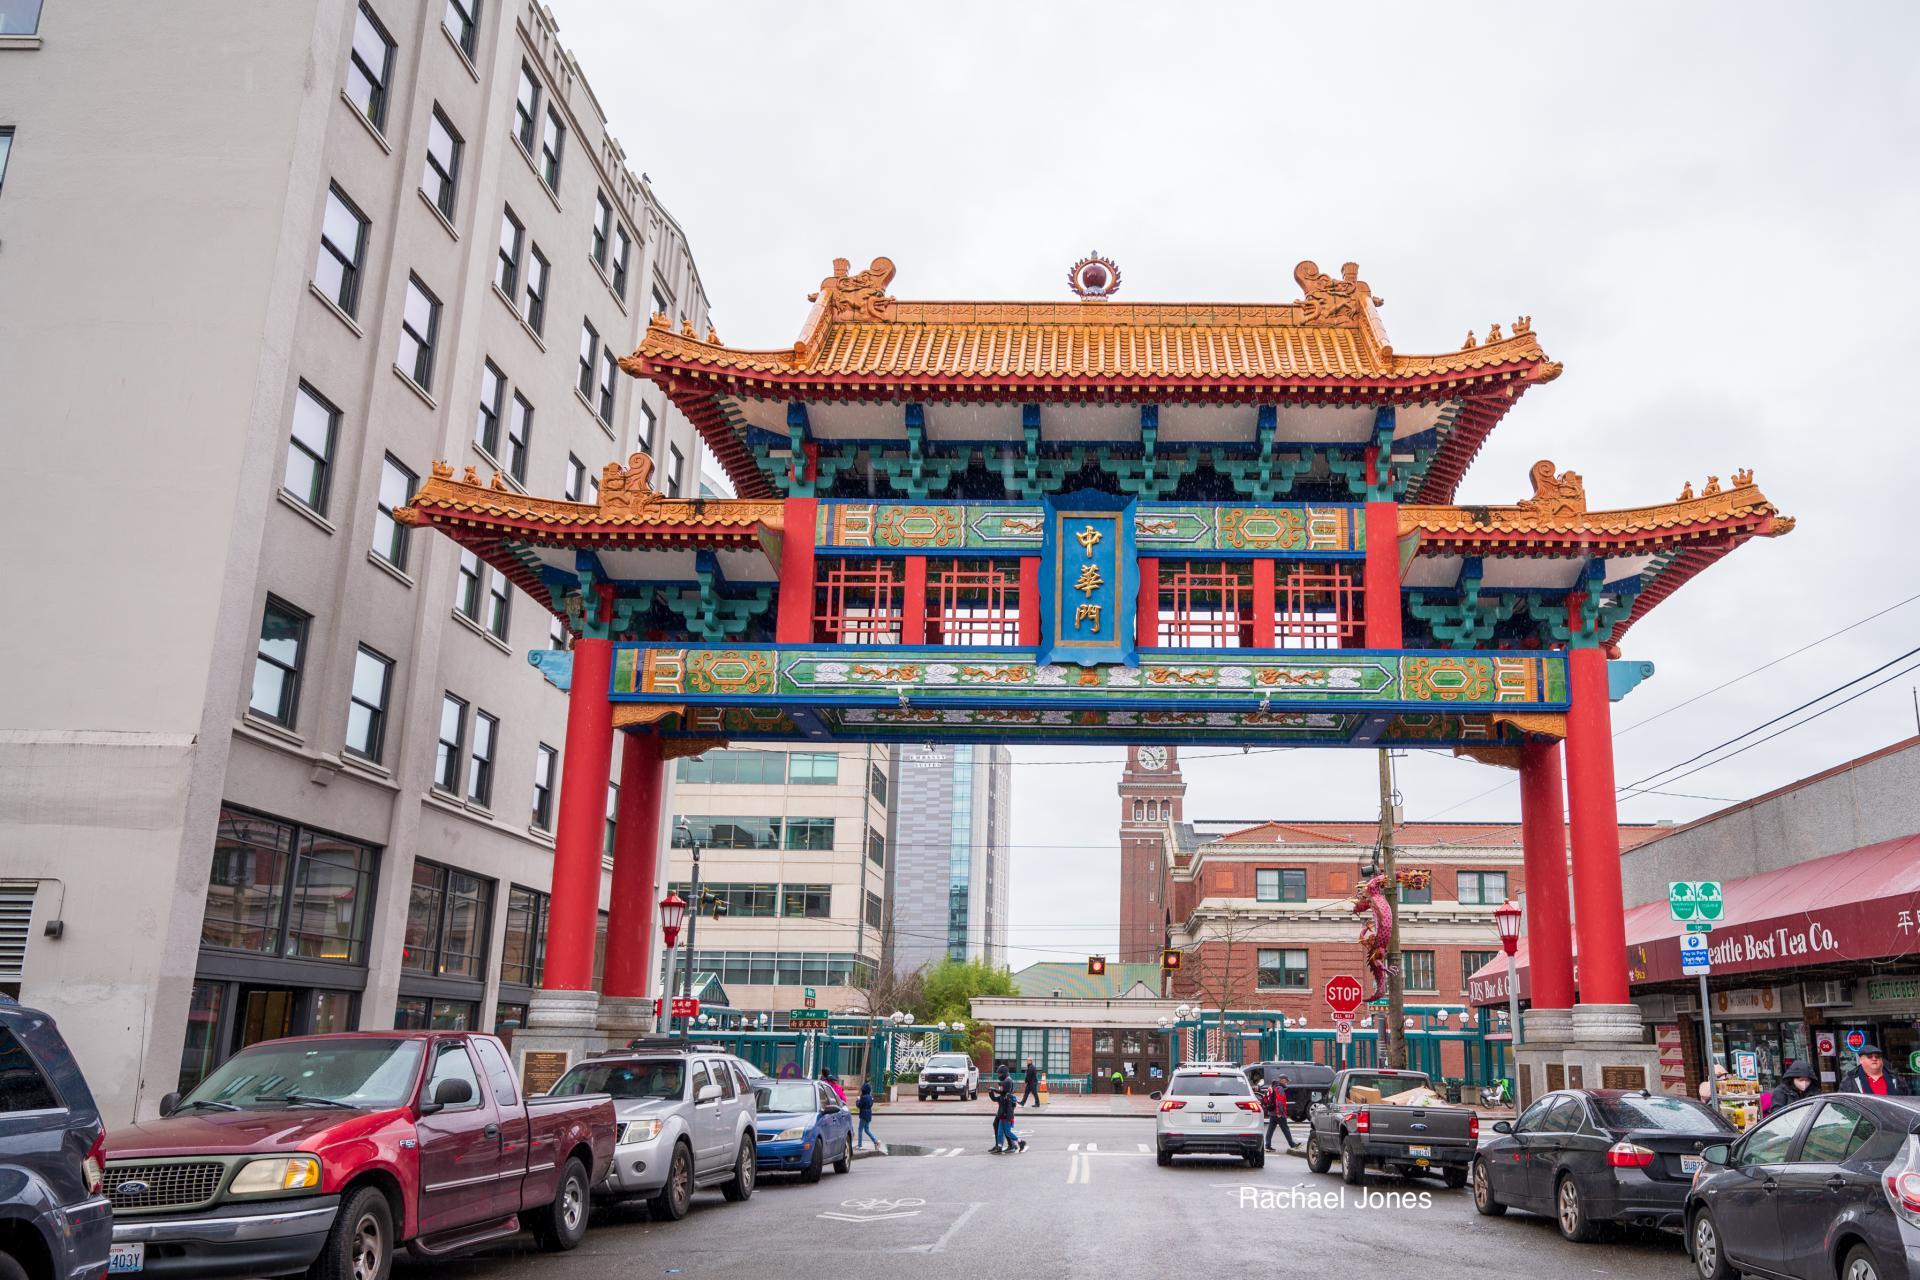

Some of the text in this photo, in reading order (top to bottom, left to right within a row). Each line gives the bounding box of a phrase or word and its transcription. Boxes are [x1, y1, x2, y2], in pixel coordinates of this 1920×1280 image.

[1073, 525, 1105, 634] 中華門
[1708, 921, 1839, 965] eattle Best Tea Co.
[1328, 986, 1360, 1001] STOP
[123, 1183, 141, 1193] Ford
